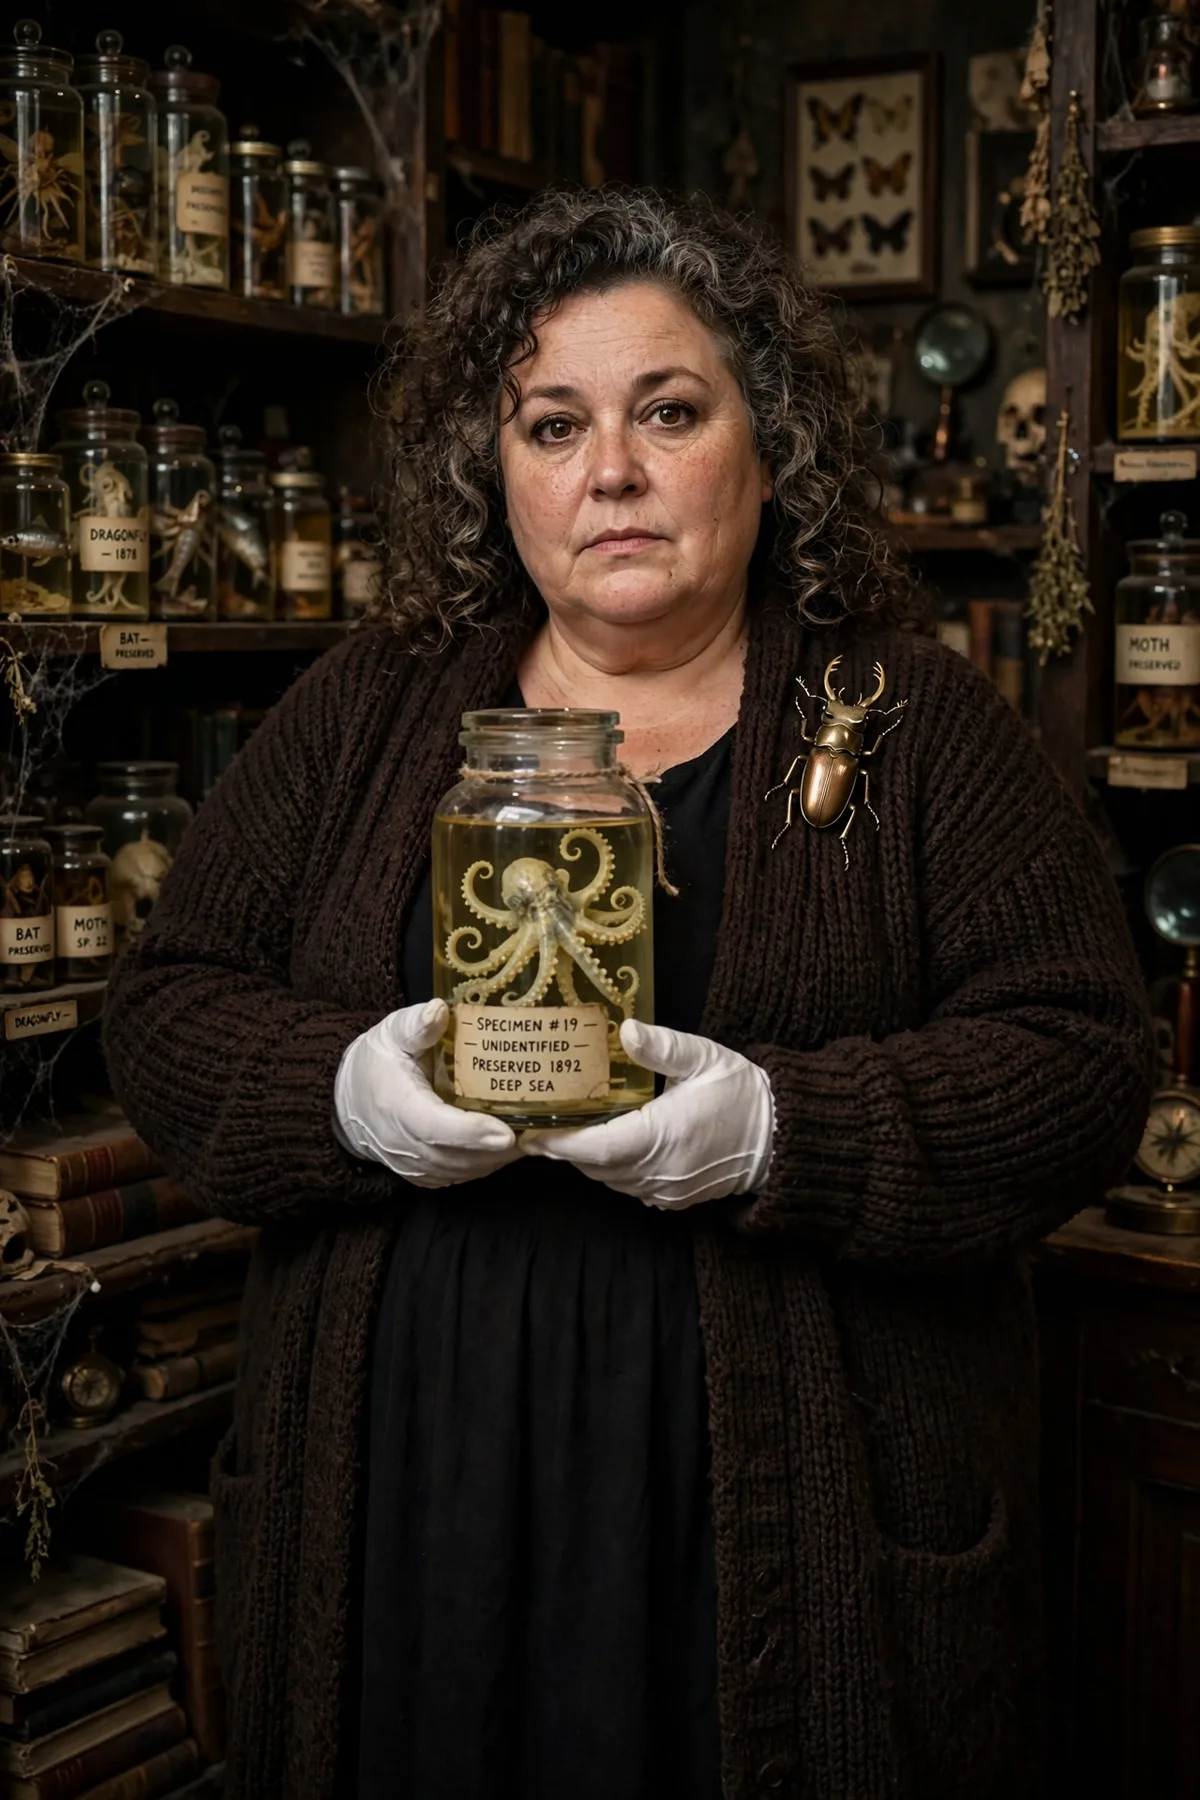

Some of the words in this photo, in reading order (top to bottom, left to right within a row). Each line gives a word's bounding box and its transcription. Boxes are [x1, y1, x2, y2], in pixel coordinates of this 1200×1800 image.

[90, 528, 148, 543] DRAGONFLY
[115, 548, 137, 560] 1878
[1128, 637, 1170, 652] MOTH
[115, 648, 155, 658] PRESERVED
[74, 917, 108, 932] MOTH
[16, 927, 41, 941] BAT
[8, 943, 51, 956] PRESERVED
[476, 1017, 542, 1032] SPECIMEN
[481, 1039, 570, 1052] UNIDENTIFIED
[472, 1057, 541, 1073] PRESERVED
[550, 1059, 582, 1073] 1892
[490, 1077, 522, 1091] DEEP
[529, 1079, 555, 1092] SEA
